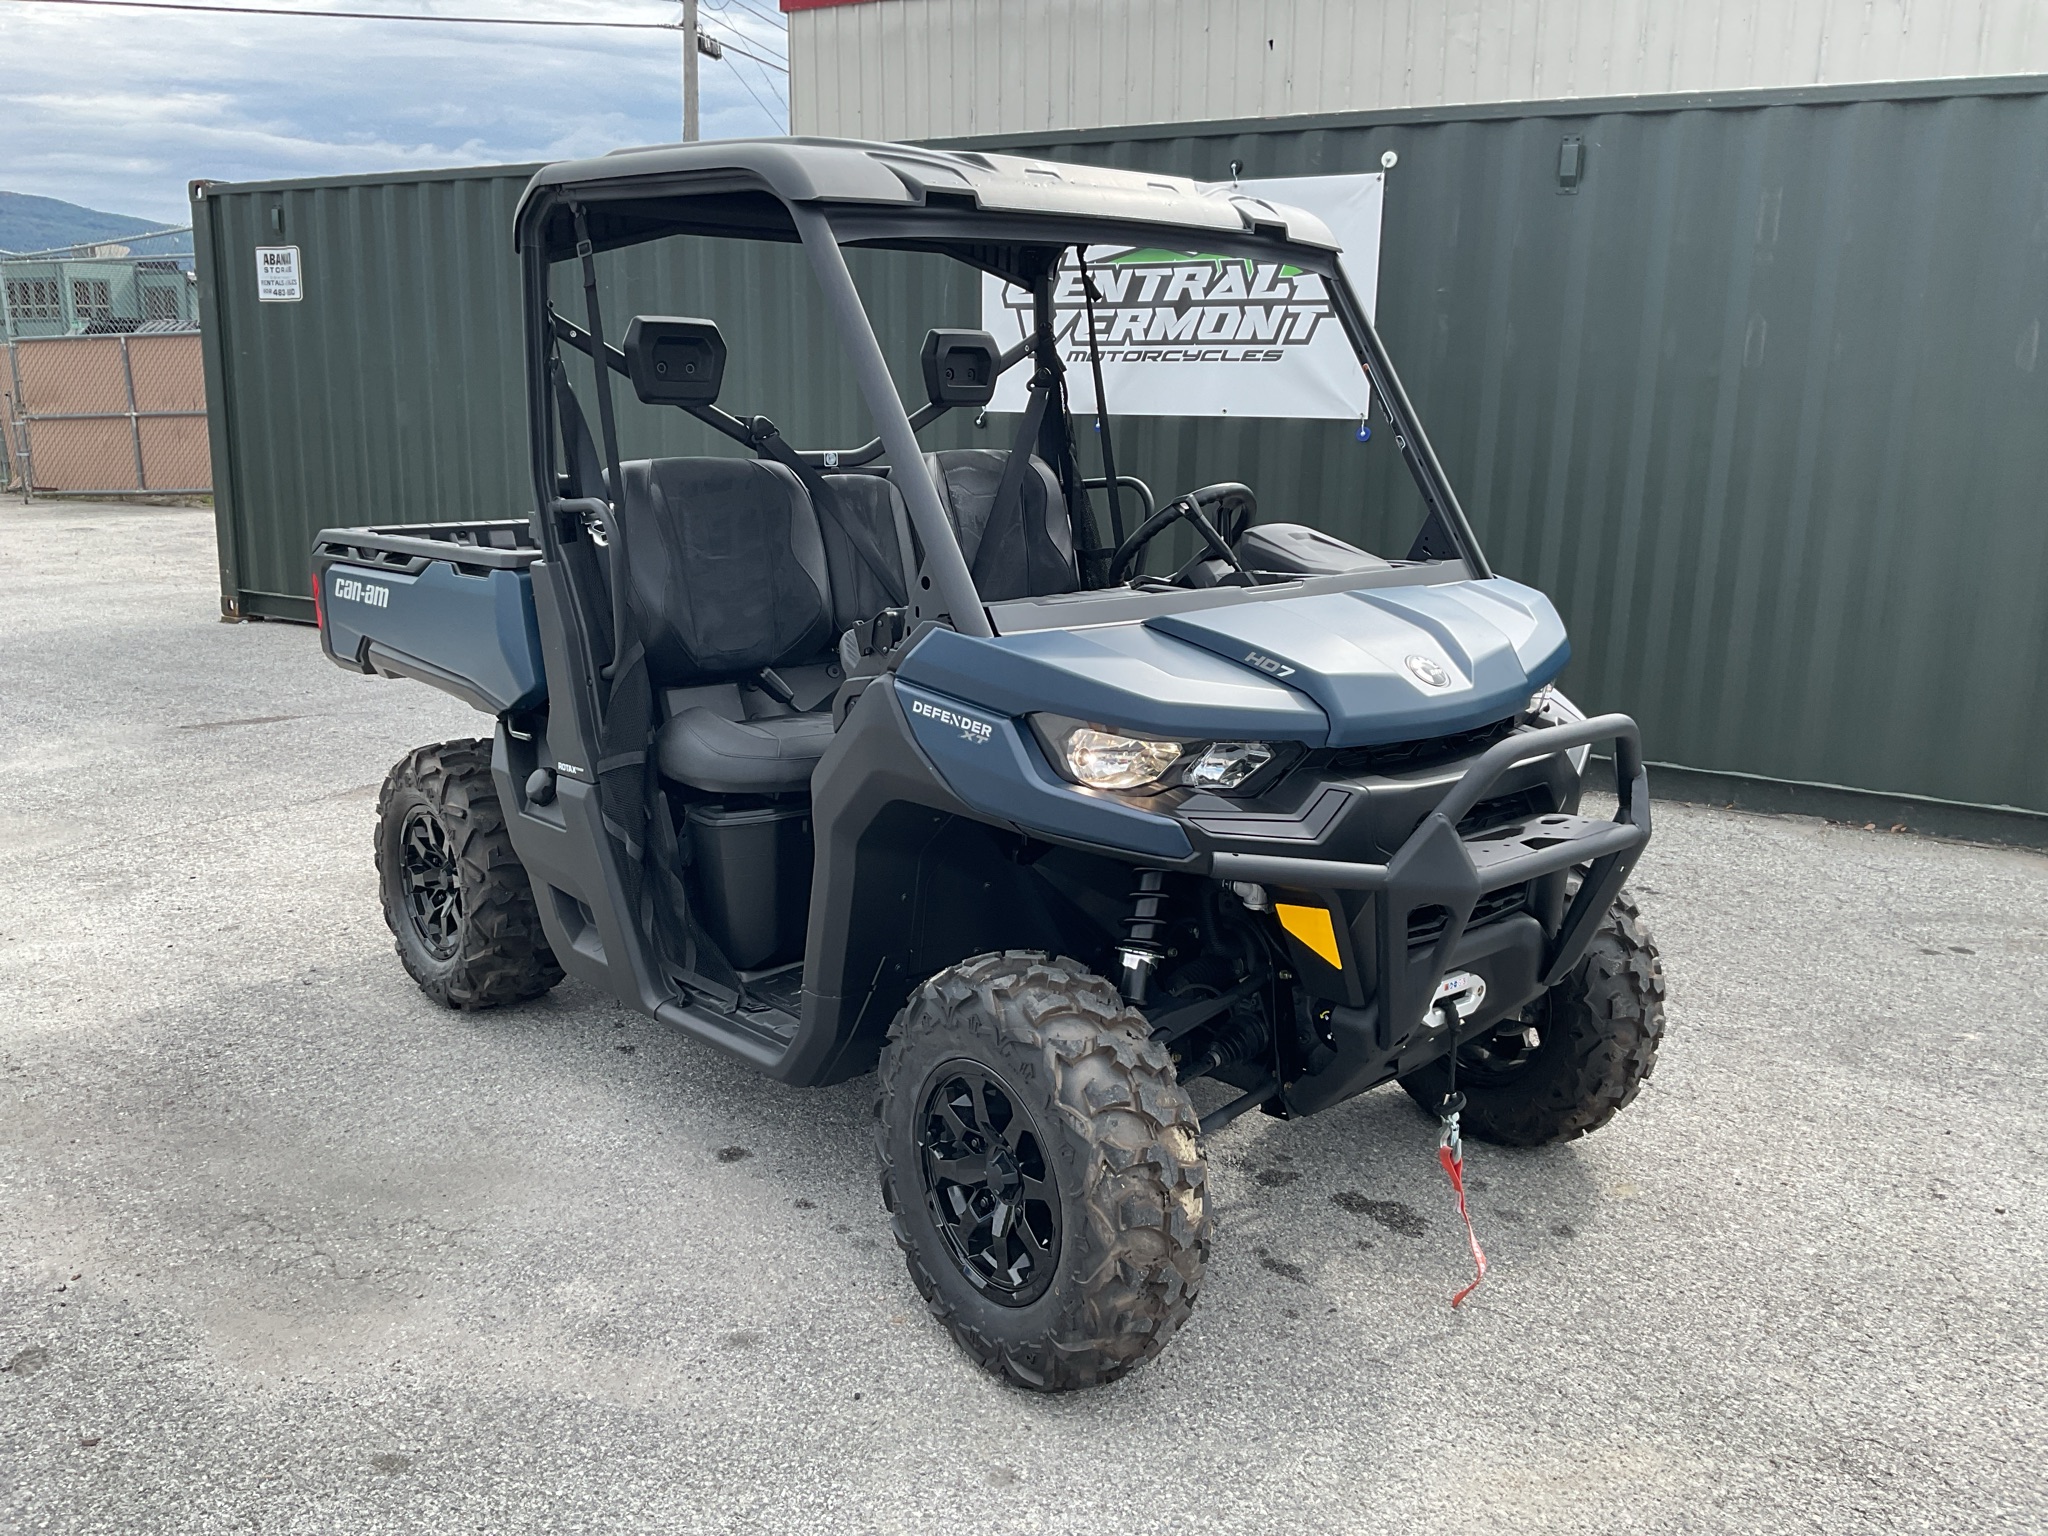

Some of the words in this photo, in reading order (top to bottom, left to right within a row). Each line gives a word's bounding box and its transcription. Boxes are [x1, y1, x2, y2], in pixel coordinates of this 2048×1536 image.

[1244, 651, 1296, 677] HD7
[912, 700, 992, 737] DEFENDER
[960, 730, 989, 744] XT
